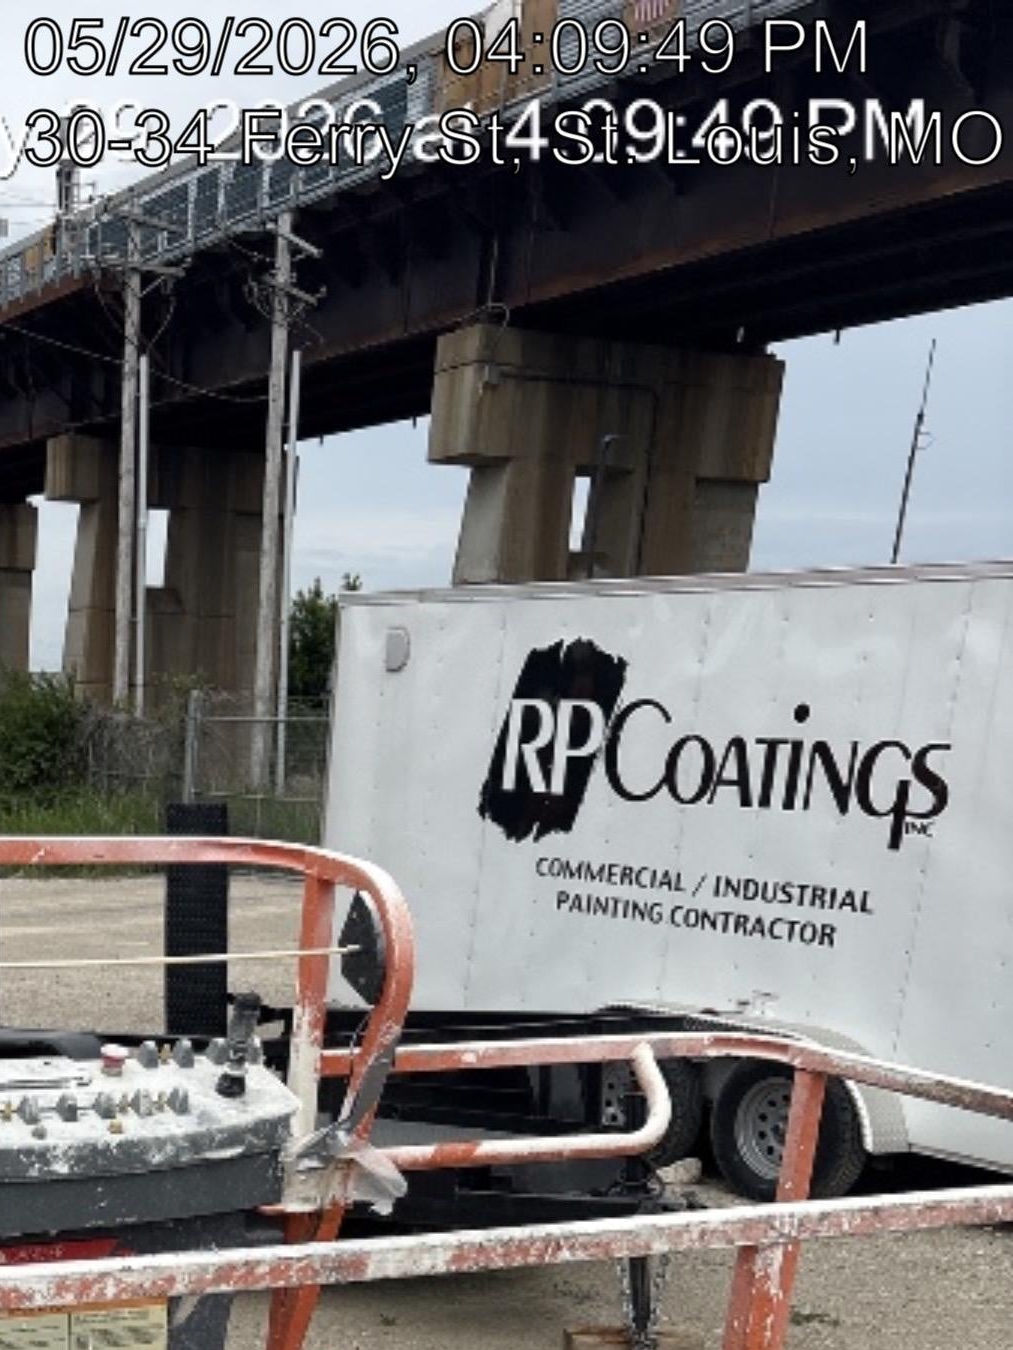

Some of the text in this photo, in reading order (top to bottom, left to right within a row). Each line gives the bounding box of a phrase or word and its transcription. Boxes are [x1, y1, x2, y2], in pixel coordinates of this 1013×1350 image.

[536, 857, 874, 915] COMMERCIAL / INDUSTRIAL
[556, 890, 838, 948] PAINTING CONTRACTOR
